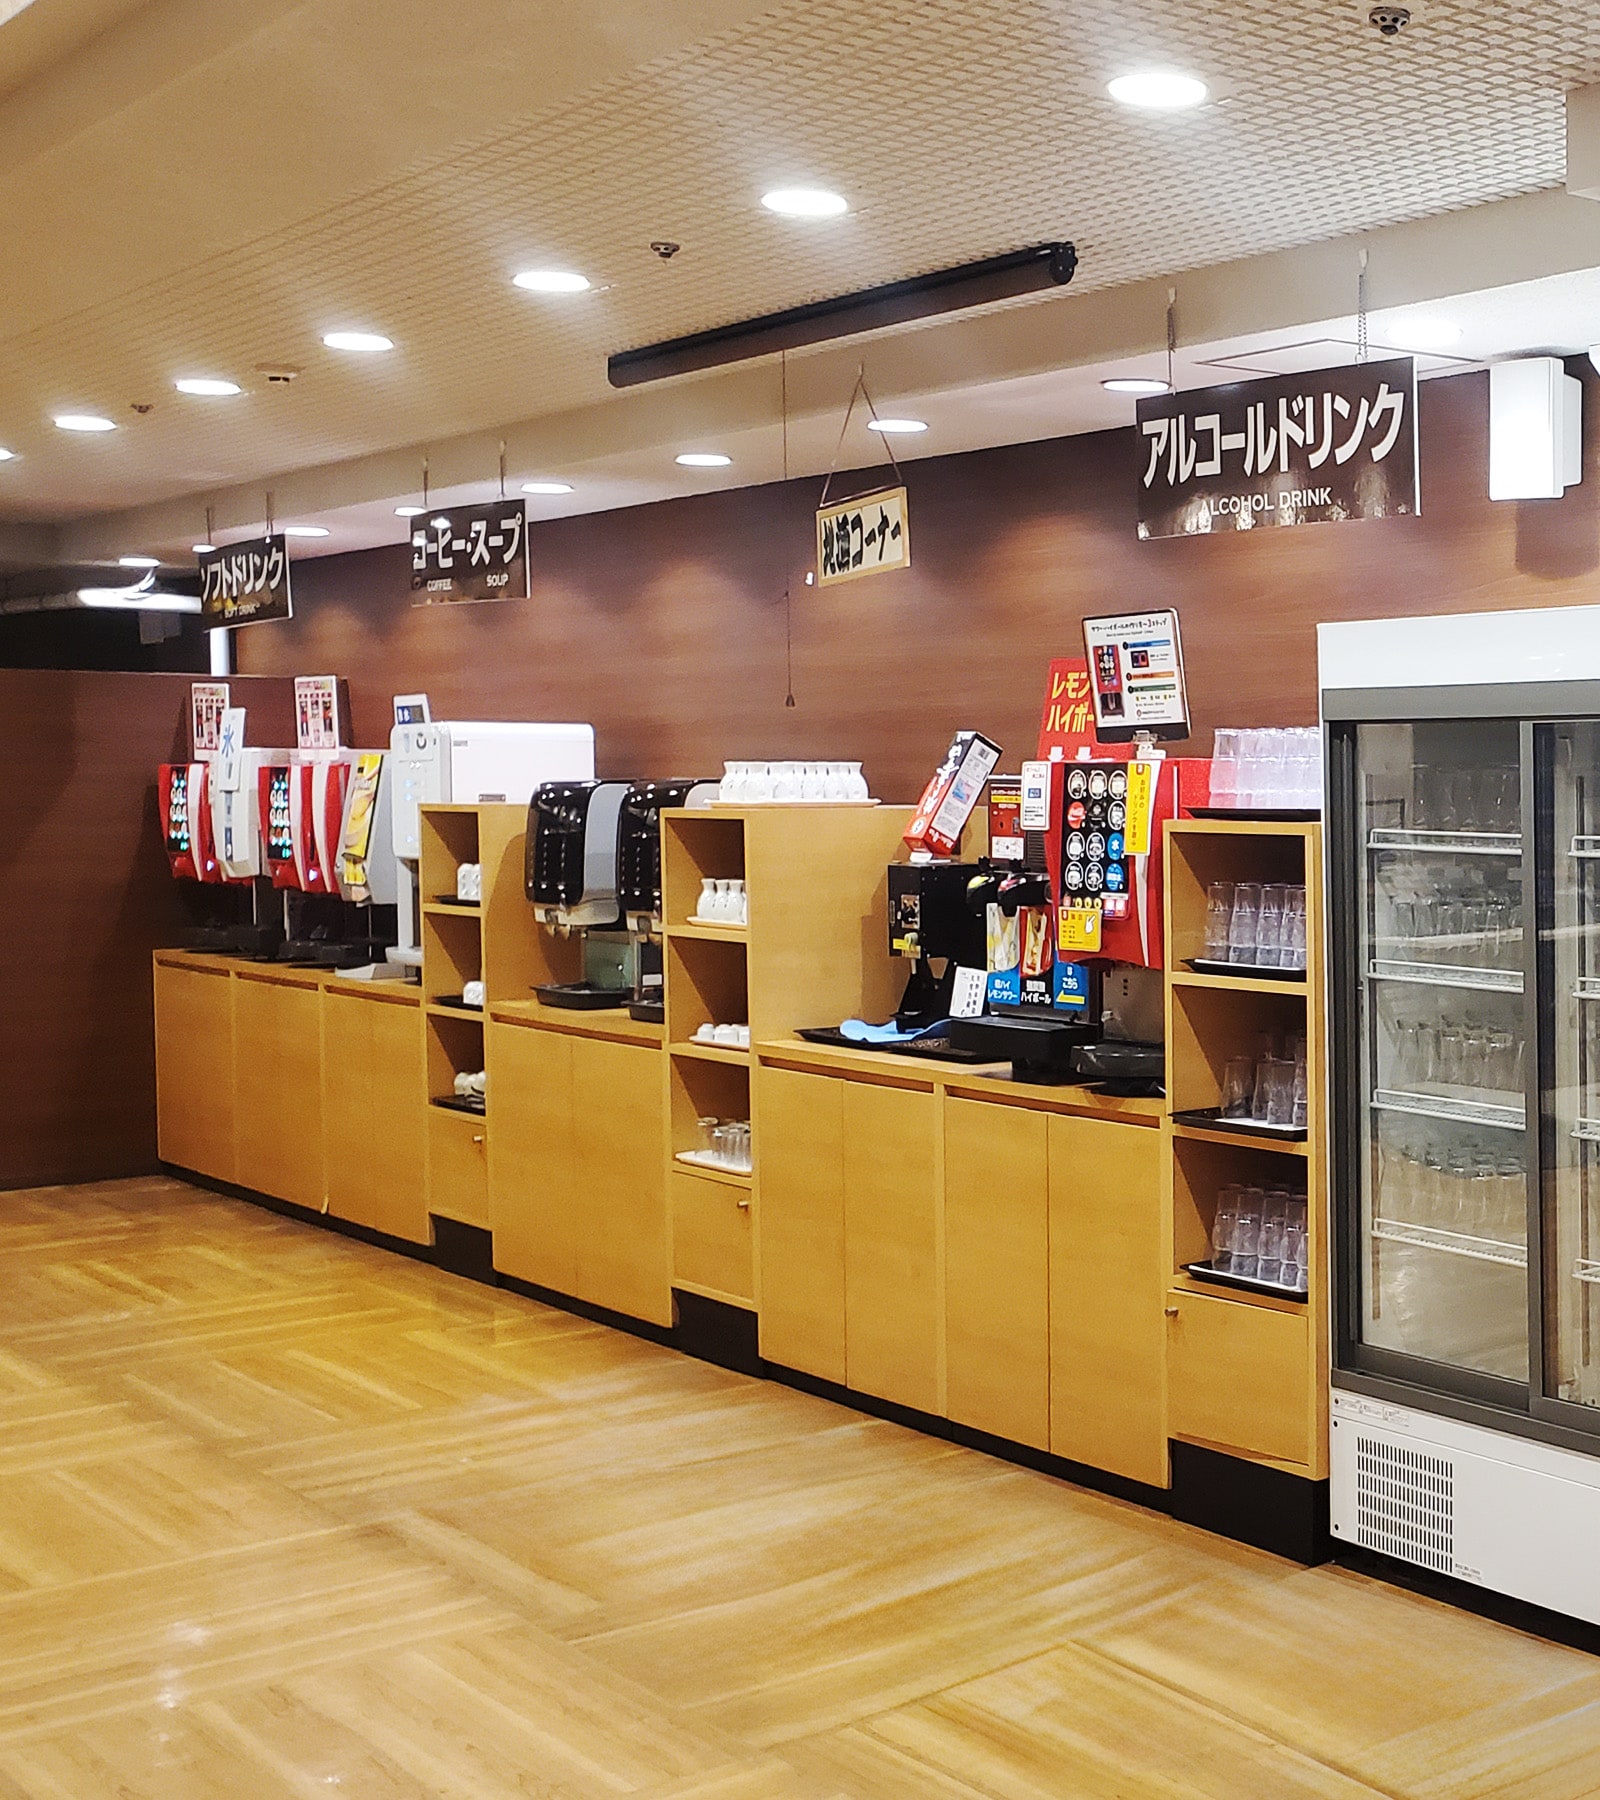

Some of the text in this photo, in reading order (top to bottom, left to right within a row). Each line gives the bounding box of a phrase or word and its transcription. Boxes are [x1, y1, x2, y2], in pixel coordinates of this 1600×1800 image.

[1142, 383, 1404, 489] アルコールドリンク
[1200, 487, 1332, 516] ALCOHOL DRINK
[200, 546, 283, 603] ソフトドリンク
[427, 578, 452, 591] COFFEE
[486, 573, 509, 587] SOUP
[1052, 672, 1091, 700] レモン
